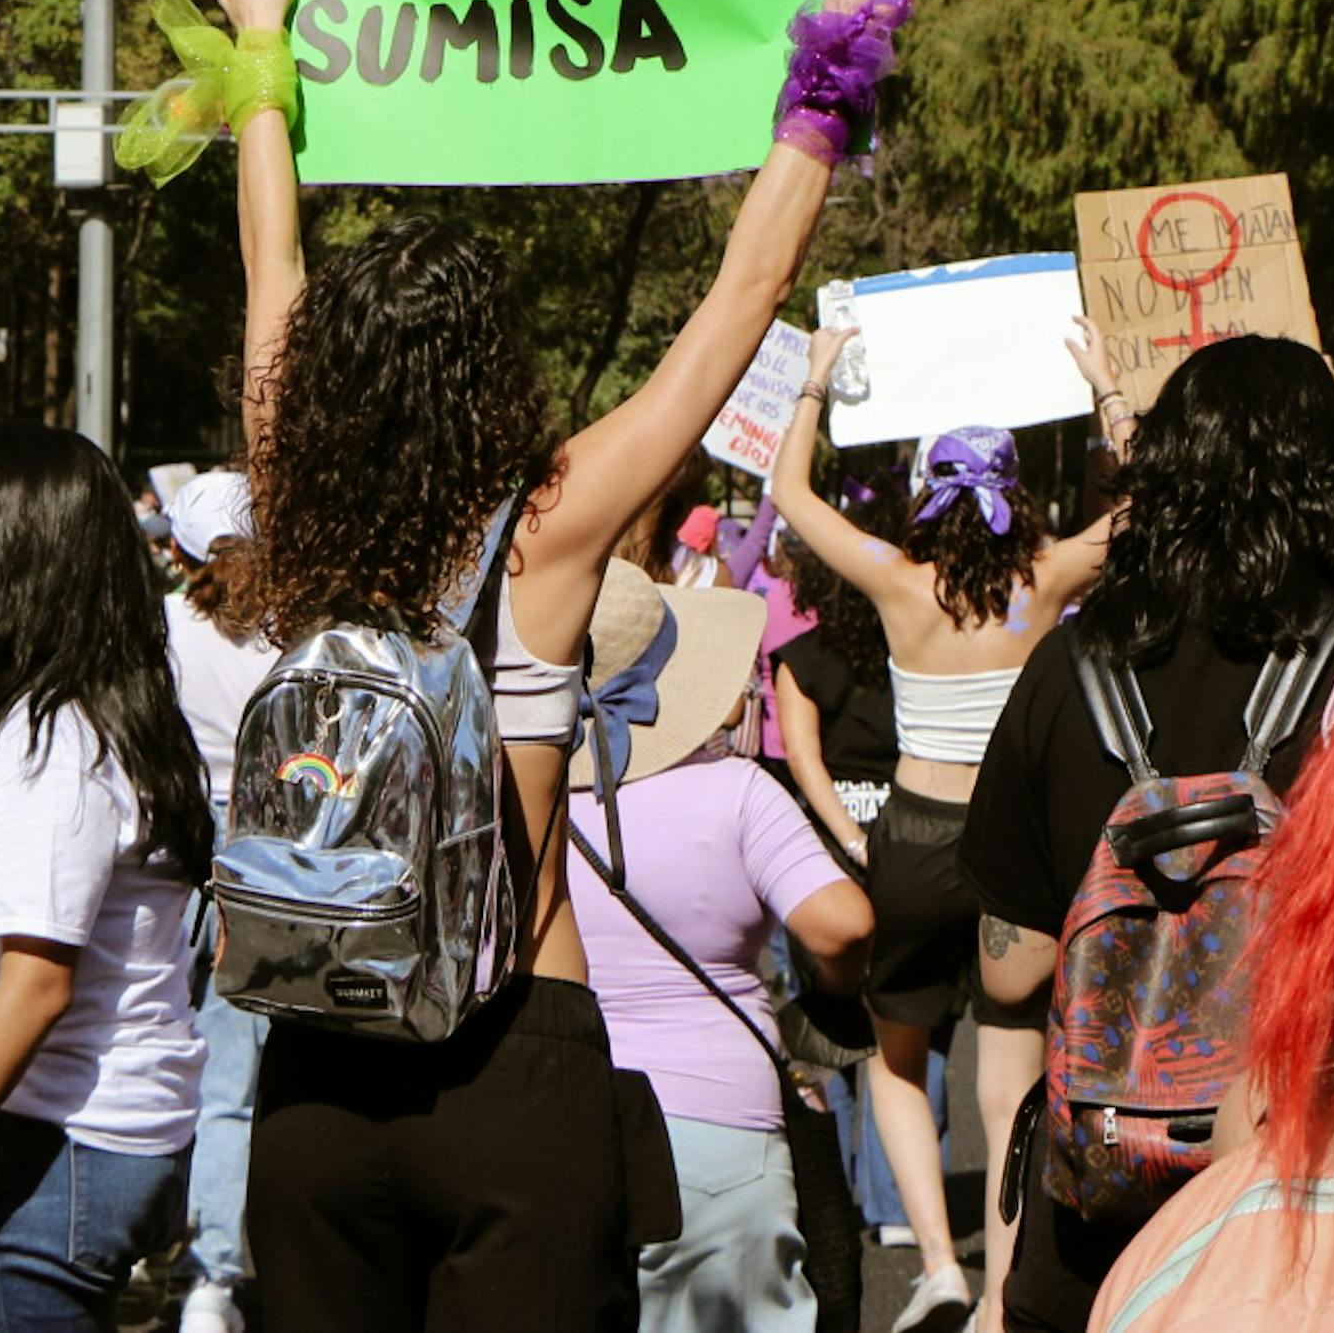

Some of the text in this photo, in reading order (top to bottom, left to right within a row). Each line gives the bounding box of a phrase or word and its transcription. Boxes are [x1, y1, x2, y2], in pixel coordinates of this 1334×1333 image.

[1101, 217, 1135, 261] SI
[1149, 216, 1200, 252] ME
[1100, 265, 1253, 321] NO DEJEN
